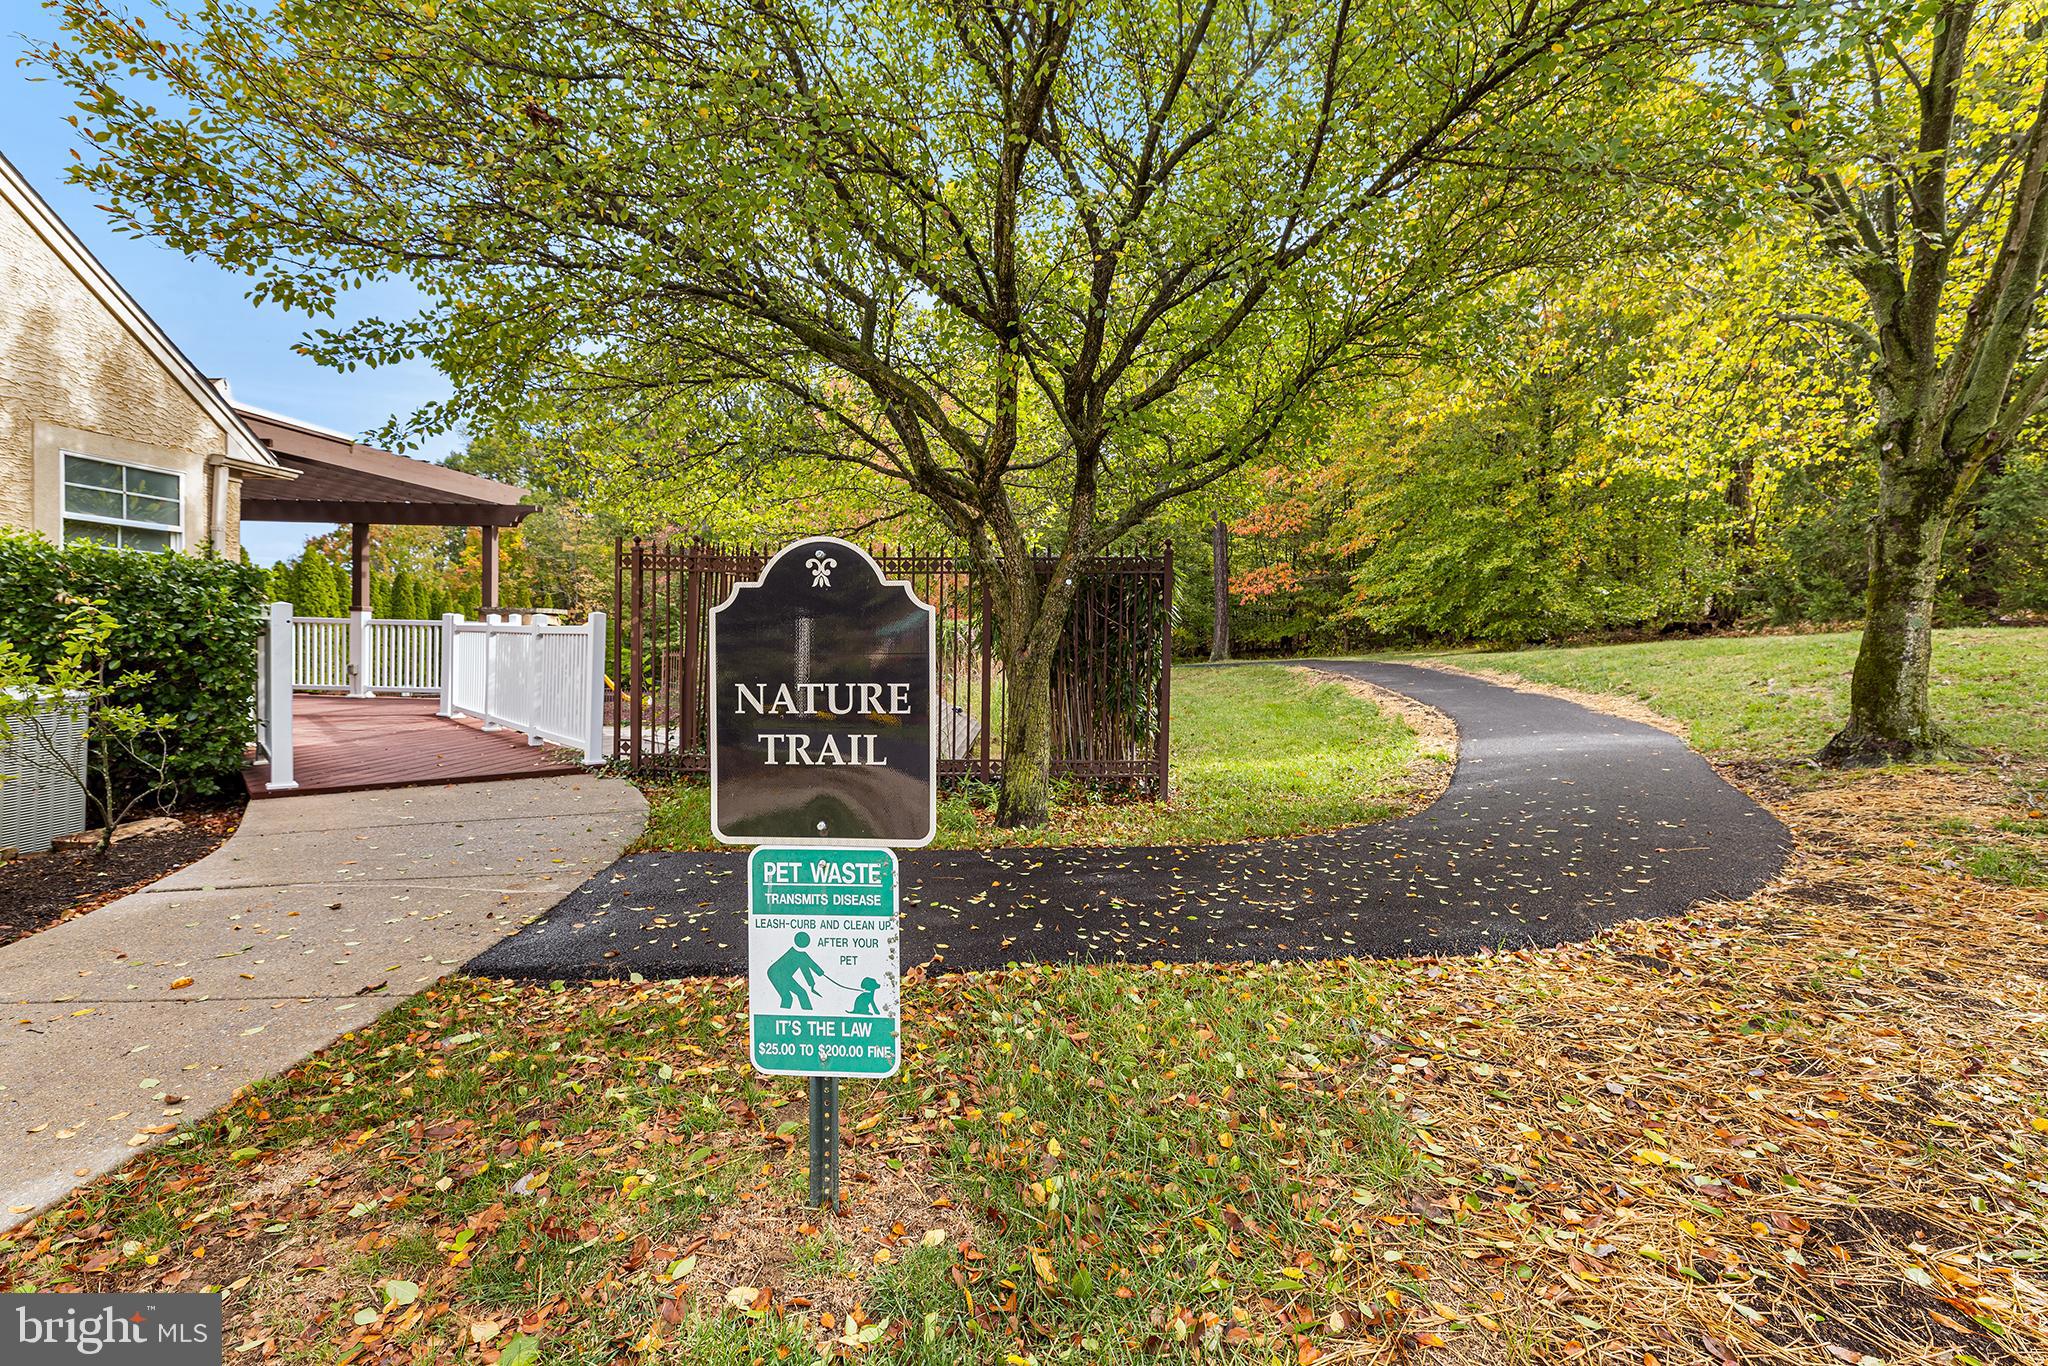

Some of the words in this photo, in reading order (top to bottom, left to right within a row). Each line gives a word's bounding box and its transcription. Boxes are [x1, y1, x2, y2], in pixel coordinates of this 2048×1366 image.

[734, 683, 912, 715] NATURE
[757, 734, 887, 765] TRAIL
[763, 862, 802, 883] PET
[810, 862, 882, 884] WASTE
[765, 893, 829, 905] TRANSMITS
[833, 894, 881, 906] DISEASE
[755, 918, 816, 929] LEASH-CURB
[820, 920, 840, 930] AND
[843, 920, 875, 930] CLEAN
[817, 937, 848, 948] AFTER
[852, 938, 879, 948] YOUR
[840, 955, 858, 965] PET
[775, 1020, 801, 1035] IT'S
[807, 1021, 836, 1037] THE
[841, 1022, 873, 1037] LAW
[758, 1042, 796, 1055] $25.00
[800, 1044, 814, 1056] TO
[818, 1044, 863, 1058] $200.00
[867, 1046, 892, 1058] FINE
